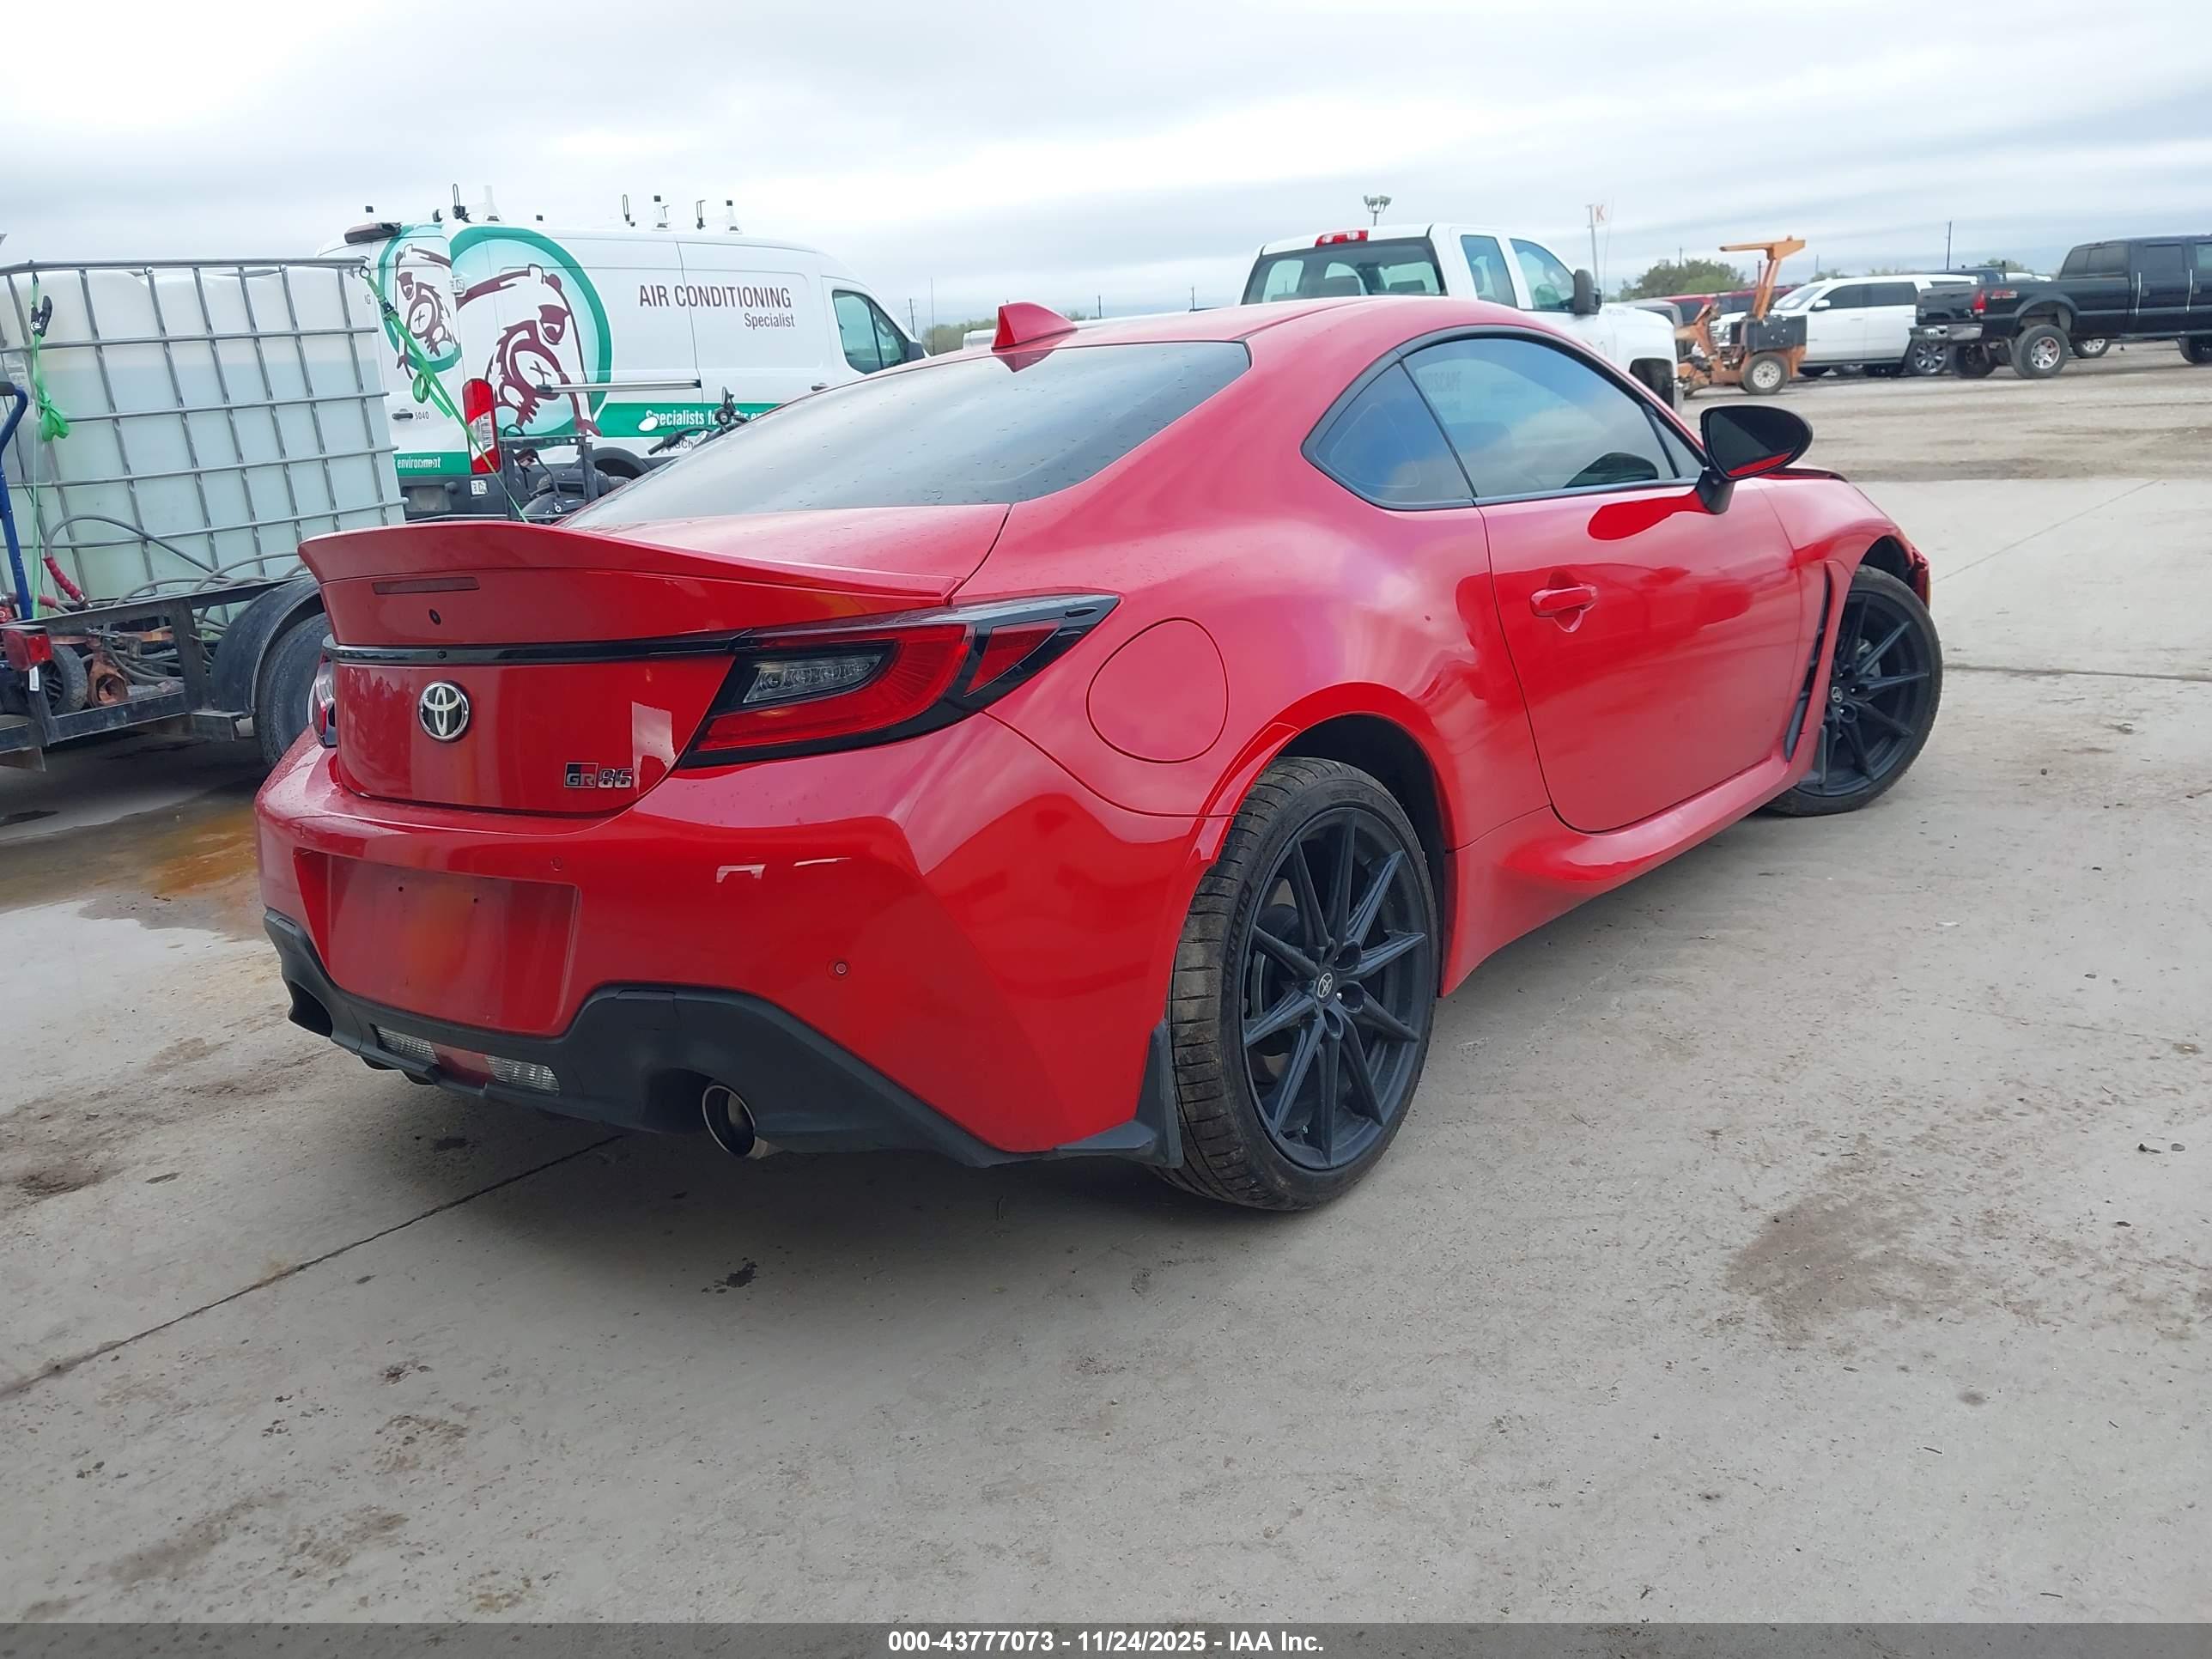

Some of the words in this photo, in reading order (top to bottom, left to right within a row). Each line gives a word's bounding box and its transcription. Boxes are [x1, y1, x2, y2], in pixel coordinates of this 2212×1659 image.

[639, 285, 670, 307] AIR
[674, 285, 792, 308] CONDITIONING
[744, 313, 795, 330] Specialist
